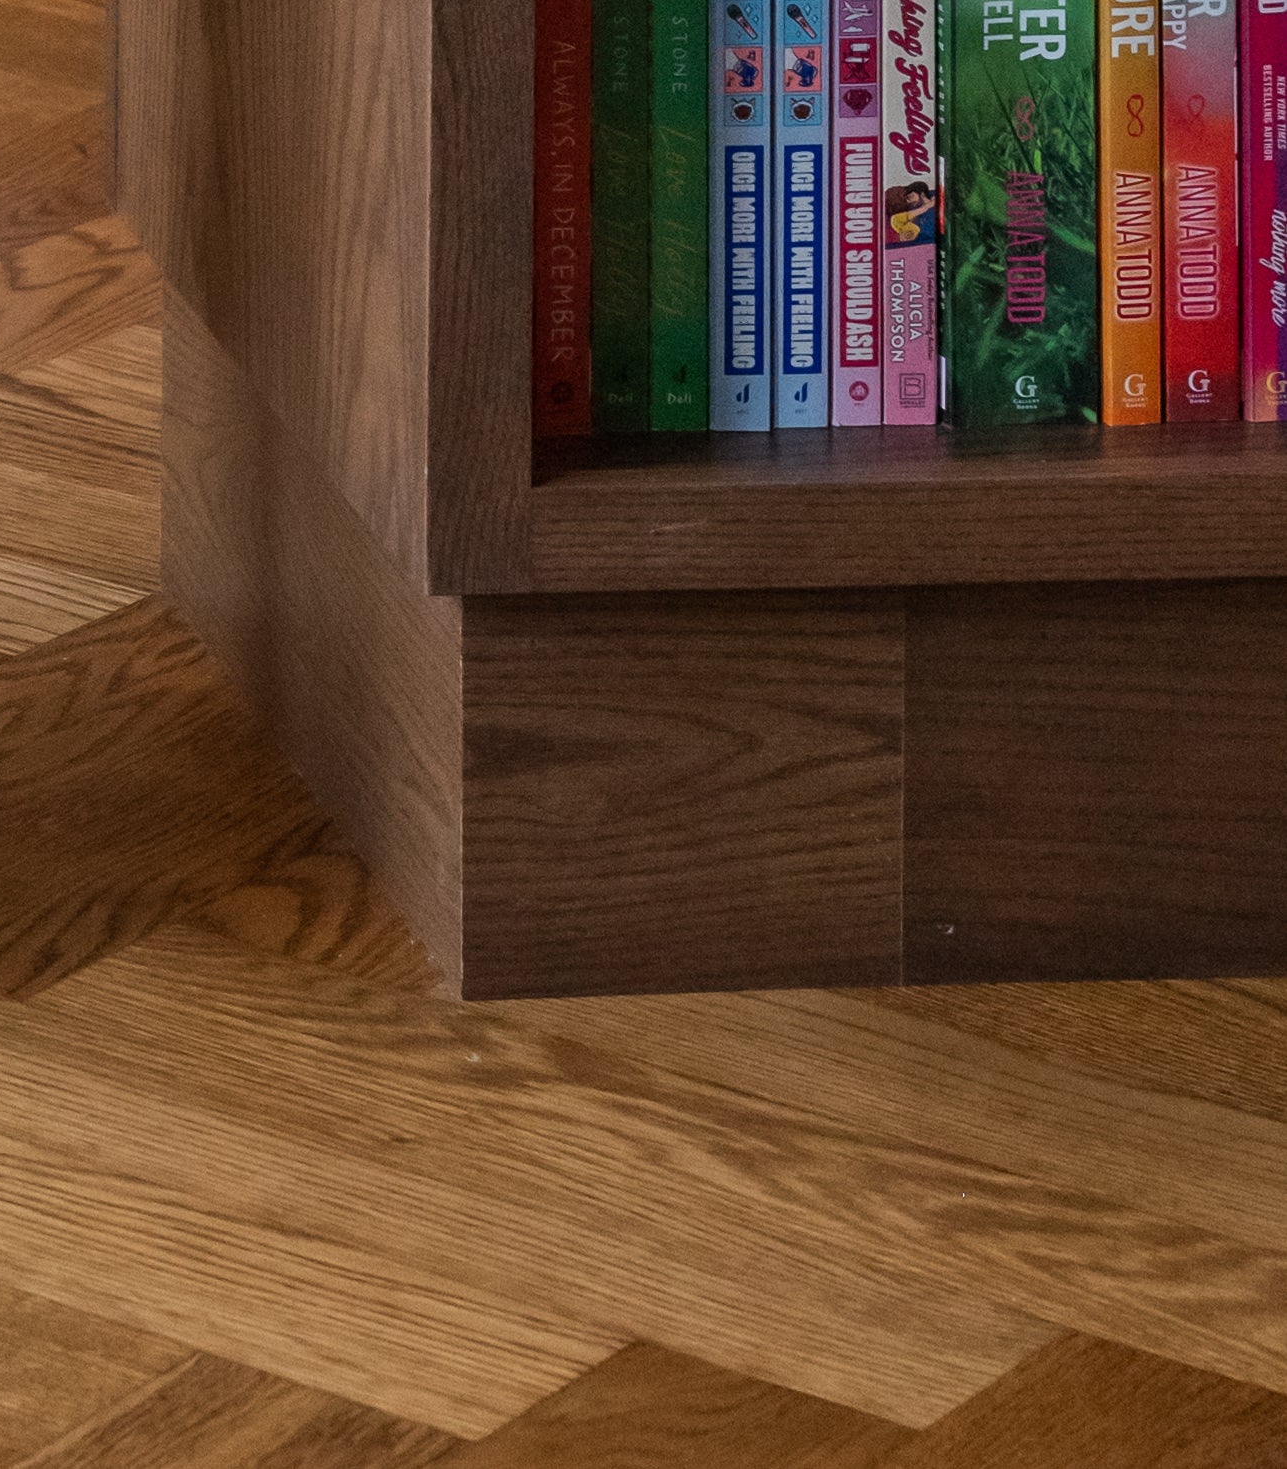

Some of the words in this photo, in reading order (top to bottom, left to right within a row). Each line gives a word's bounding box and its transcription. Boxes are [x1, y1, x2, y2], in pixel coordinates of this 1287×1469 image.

[888, 56, 934, 176] Feelings
[1263, 64, 1273, 124] BESTSELLING
[731, 151, 756, 193] ONCE
[844, 142, 874, 203] FUNNY
[1263, 126, 1273, 161] AUTHOR
[551, 163, 573, 193] IN
[731, 196, 756, 243] MORE
[844, 204, 874, 244] YOU
[1116, 173, 1153, 246] ANNA
[732, 247, 756, 291] WITH
[1259, 209, 1287, 275] nothing
[551, 207, 576, 363] DECEMBER
[845, 249, 874, 321] SHOULD
[890, 259, 905, 362] THOMPSON
[908, 281, 923, 341] ALICIA
[1116, 249, 1153, 320] TODD
[1270, 280, 1287, 327] more
[732, 294, 756, 370] FEELING
